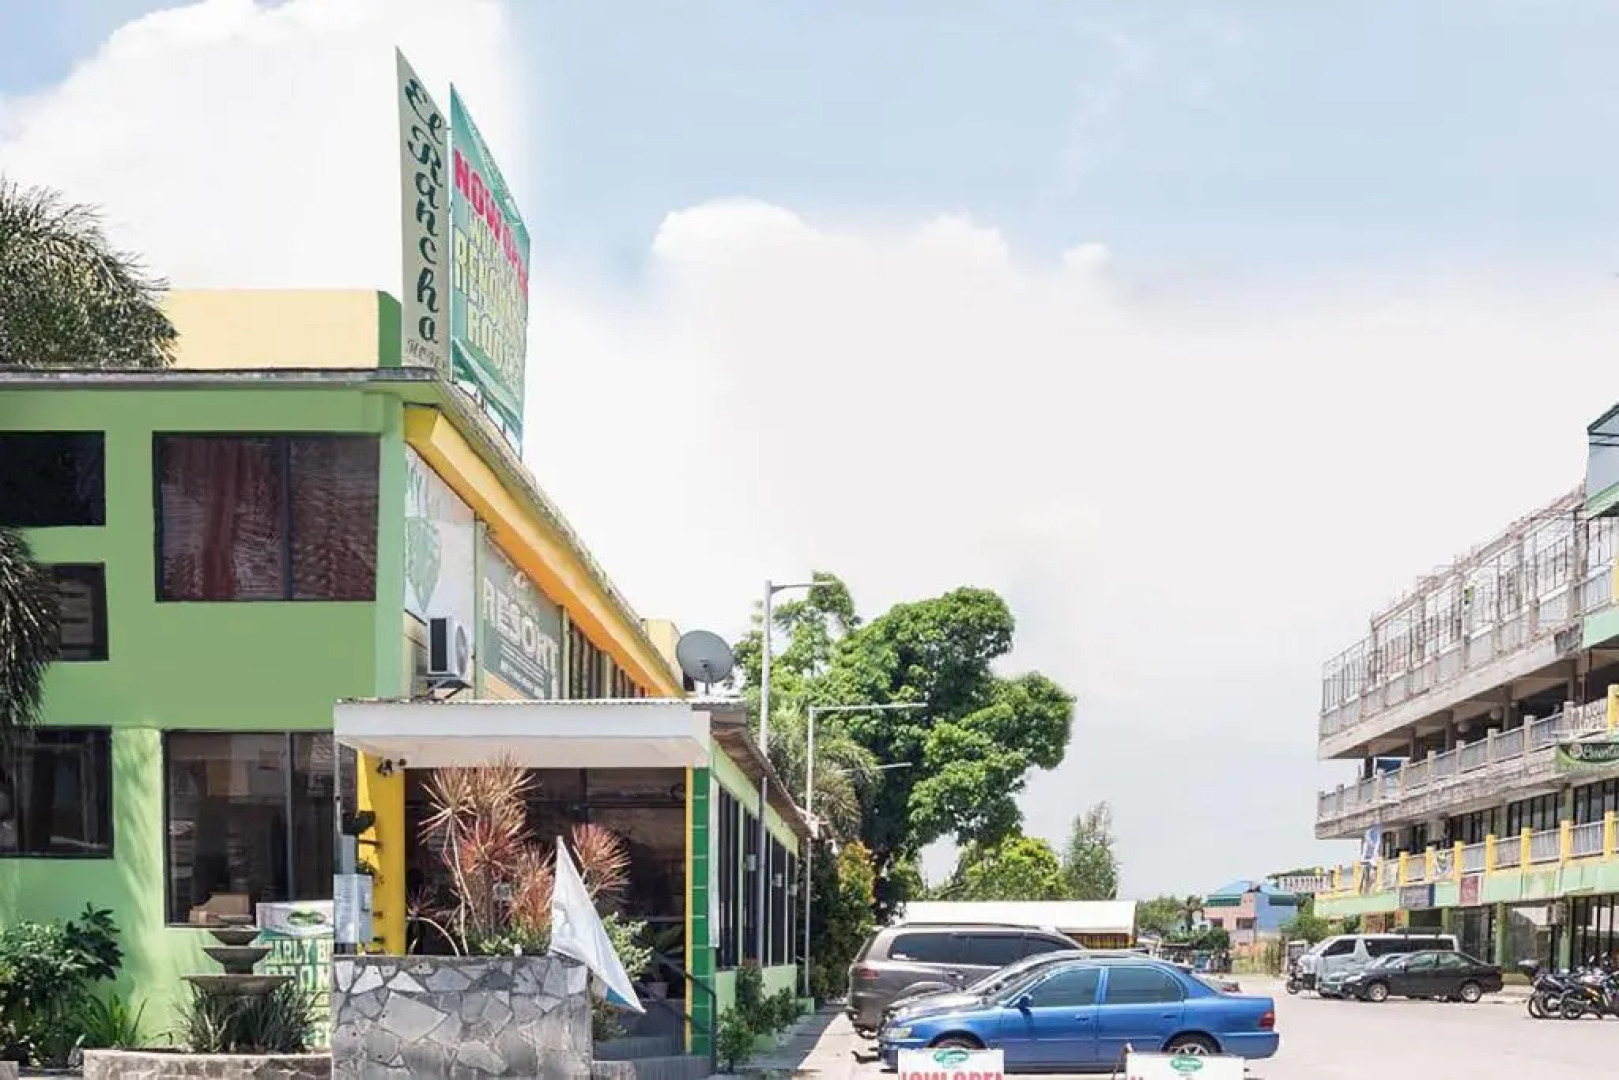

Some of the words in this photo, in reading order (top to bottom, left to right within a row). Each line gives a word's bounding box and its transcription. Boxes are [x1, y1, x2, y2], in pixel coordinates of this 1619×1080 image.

[405, 79, 443, 145] El
[454, 148, 502, 242] NOW
[467, 300, 522, 392] ROO
[483, 576, 559, 677] RESORT
